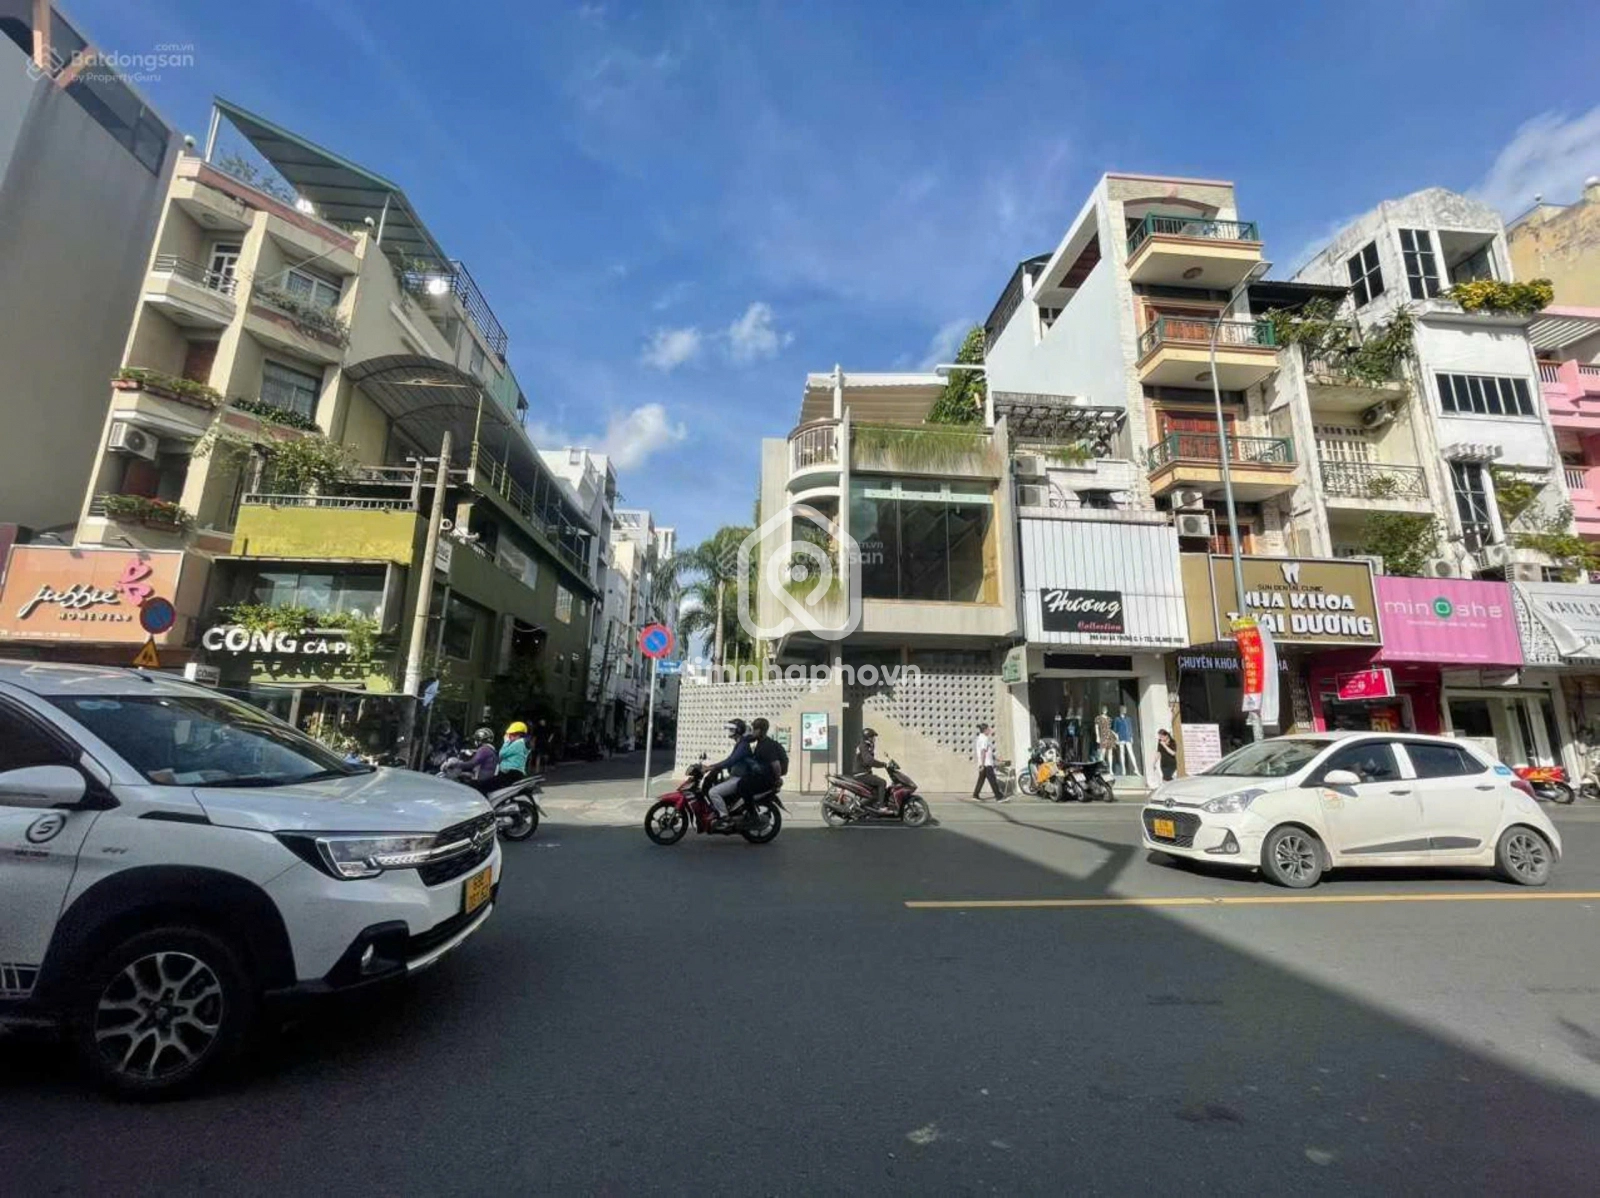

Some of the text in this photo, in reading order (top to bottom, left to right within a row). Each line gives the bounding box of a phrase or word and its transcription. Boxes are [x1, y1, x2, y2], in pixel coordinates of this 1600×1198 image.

[1290, 593, 1355, 610] KHOA
[1292, 612, 1374, 636] DƯƠNG
[1215, 657, 1239, 670] KHOA
